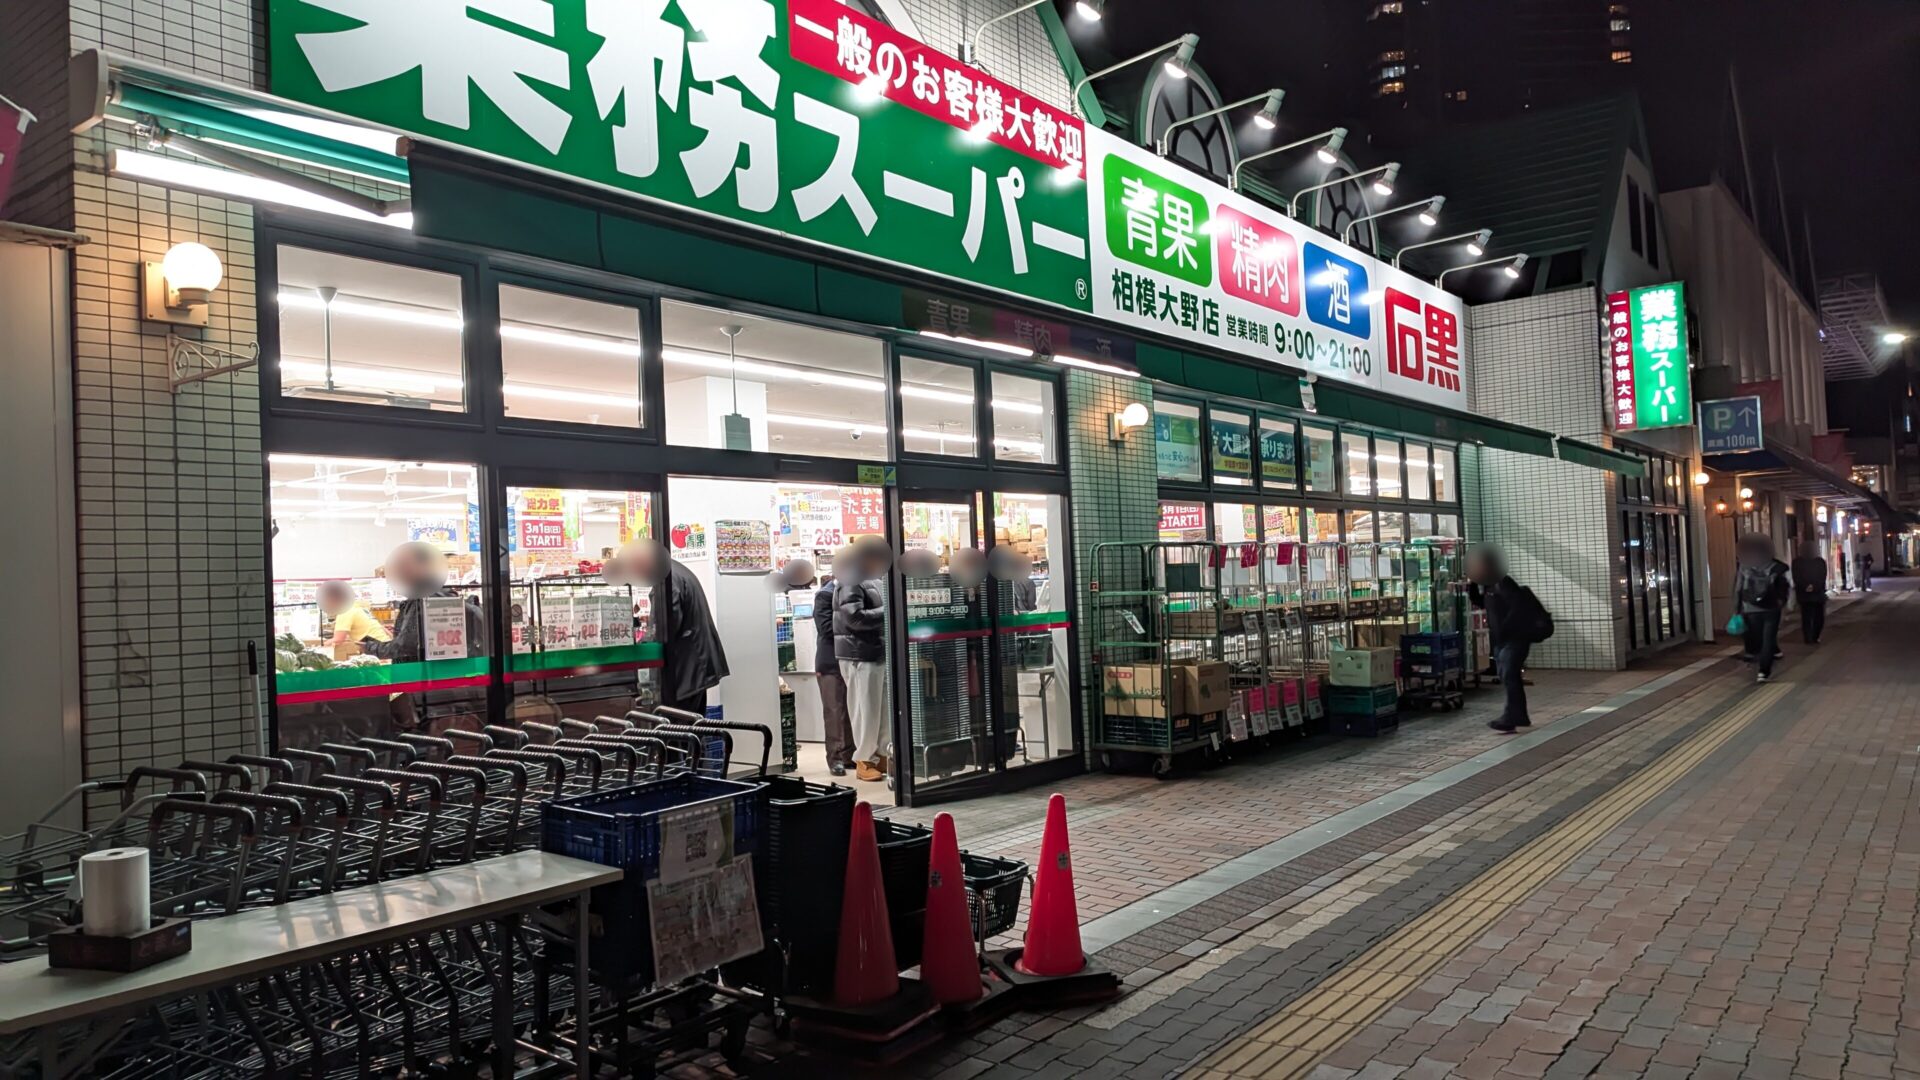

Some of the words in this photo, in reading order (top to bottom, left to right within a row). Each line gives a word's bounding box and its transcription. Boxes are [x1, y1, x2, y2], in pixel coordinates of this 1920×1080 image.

[794, 15, 1084, 174] 一般のお客様大歓迎
[1121, 175, 1198, 270] 青果
[1231, 222, 1290, 304] 精肉
[1112, 267, 1220, 337] 相模大野店
[1226, 313, 1269, 347] 営業時間
[1323, 259, 1352, 325] 酒
[1384, 286, 1461, 393] 石黒
[1639, 288, 1678, 423] 業務スーパー
[1611, 300, 1634, 425] 一般のお客様大歓迎
[1726, 434, 1756, 448] 100m
[525, 522, 561, 534] 3月1日(日)
[526, 534, 562, 547] START!!
[686, 533, 706, 549] 青果
[815, 528, 841, 546] 265
[856, 516, 880, 530] 売場
[1160, 514, 1200, 528] START!!
[522, 624, 597, 646] 業務スーパー
